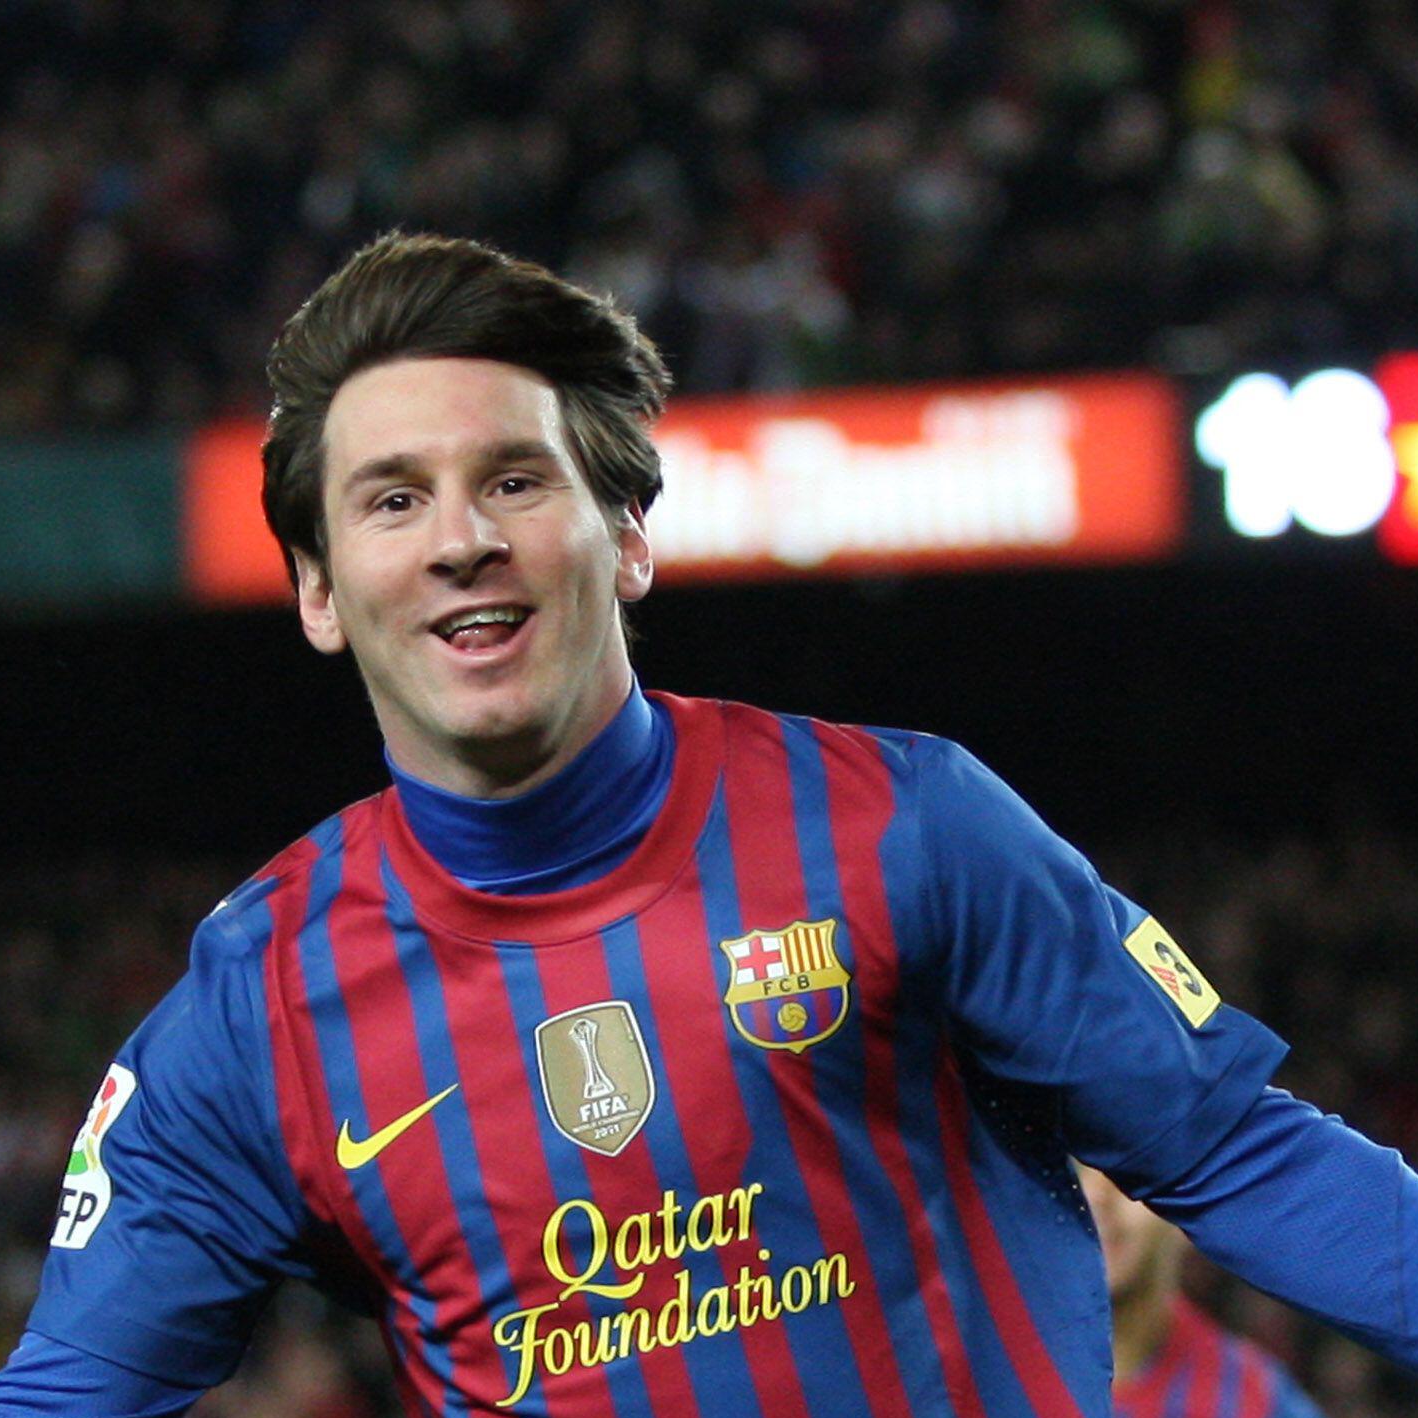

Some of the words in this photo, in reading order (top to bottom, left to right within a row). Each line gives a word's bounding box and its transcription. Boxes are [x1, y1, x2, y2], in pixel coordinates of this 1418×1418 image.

[579, 1095, 627, 1122] FIFA
[543, 1182, 764, 1301] Qatar
[493, 1248, 856, 1407] Foundation
